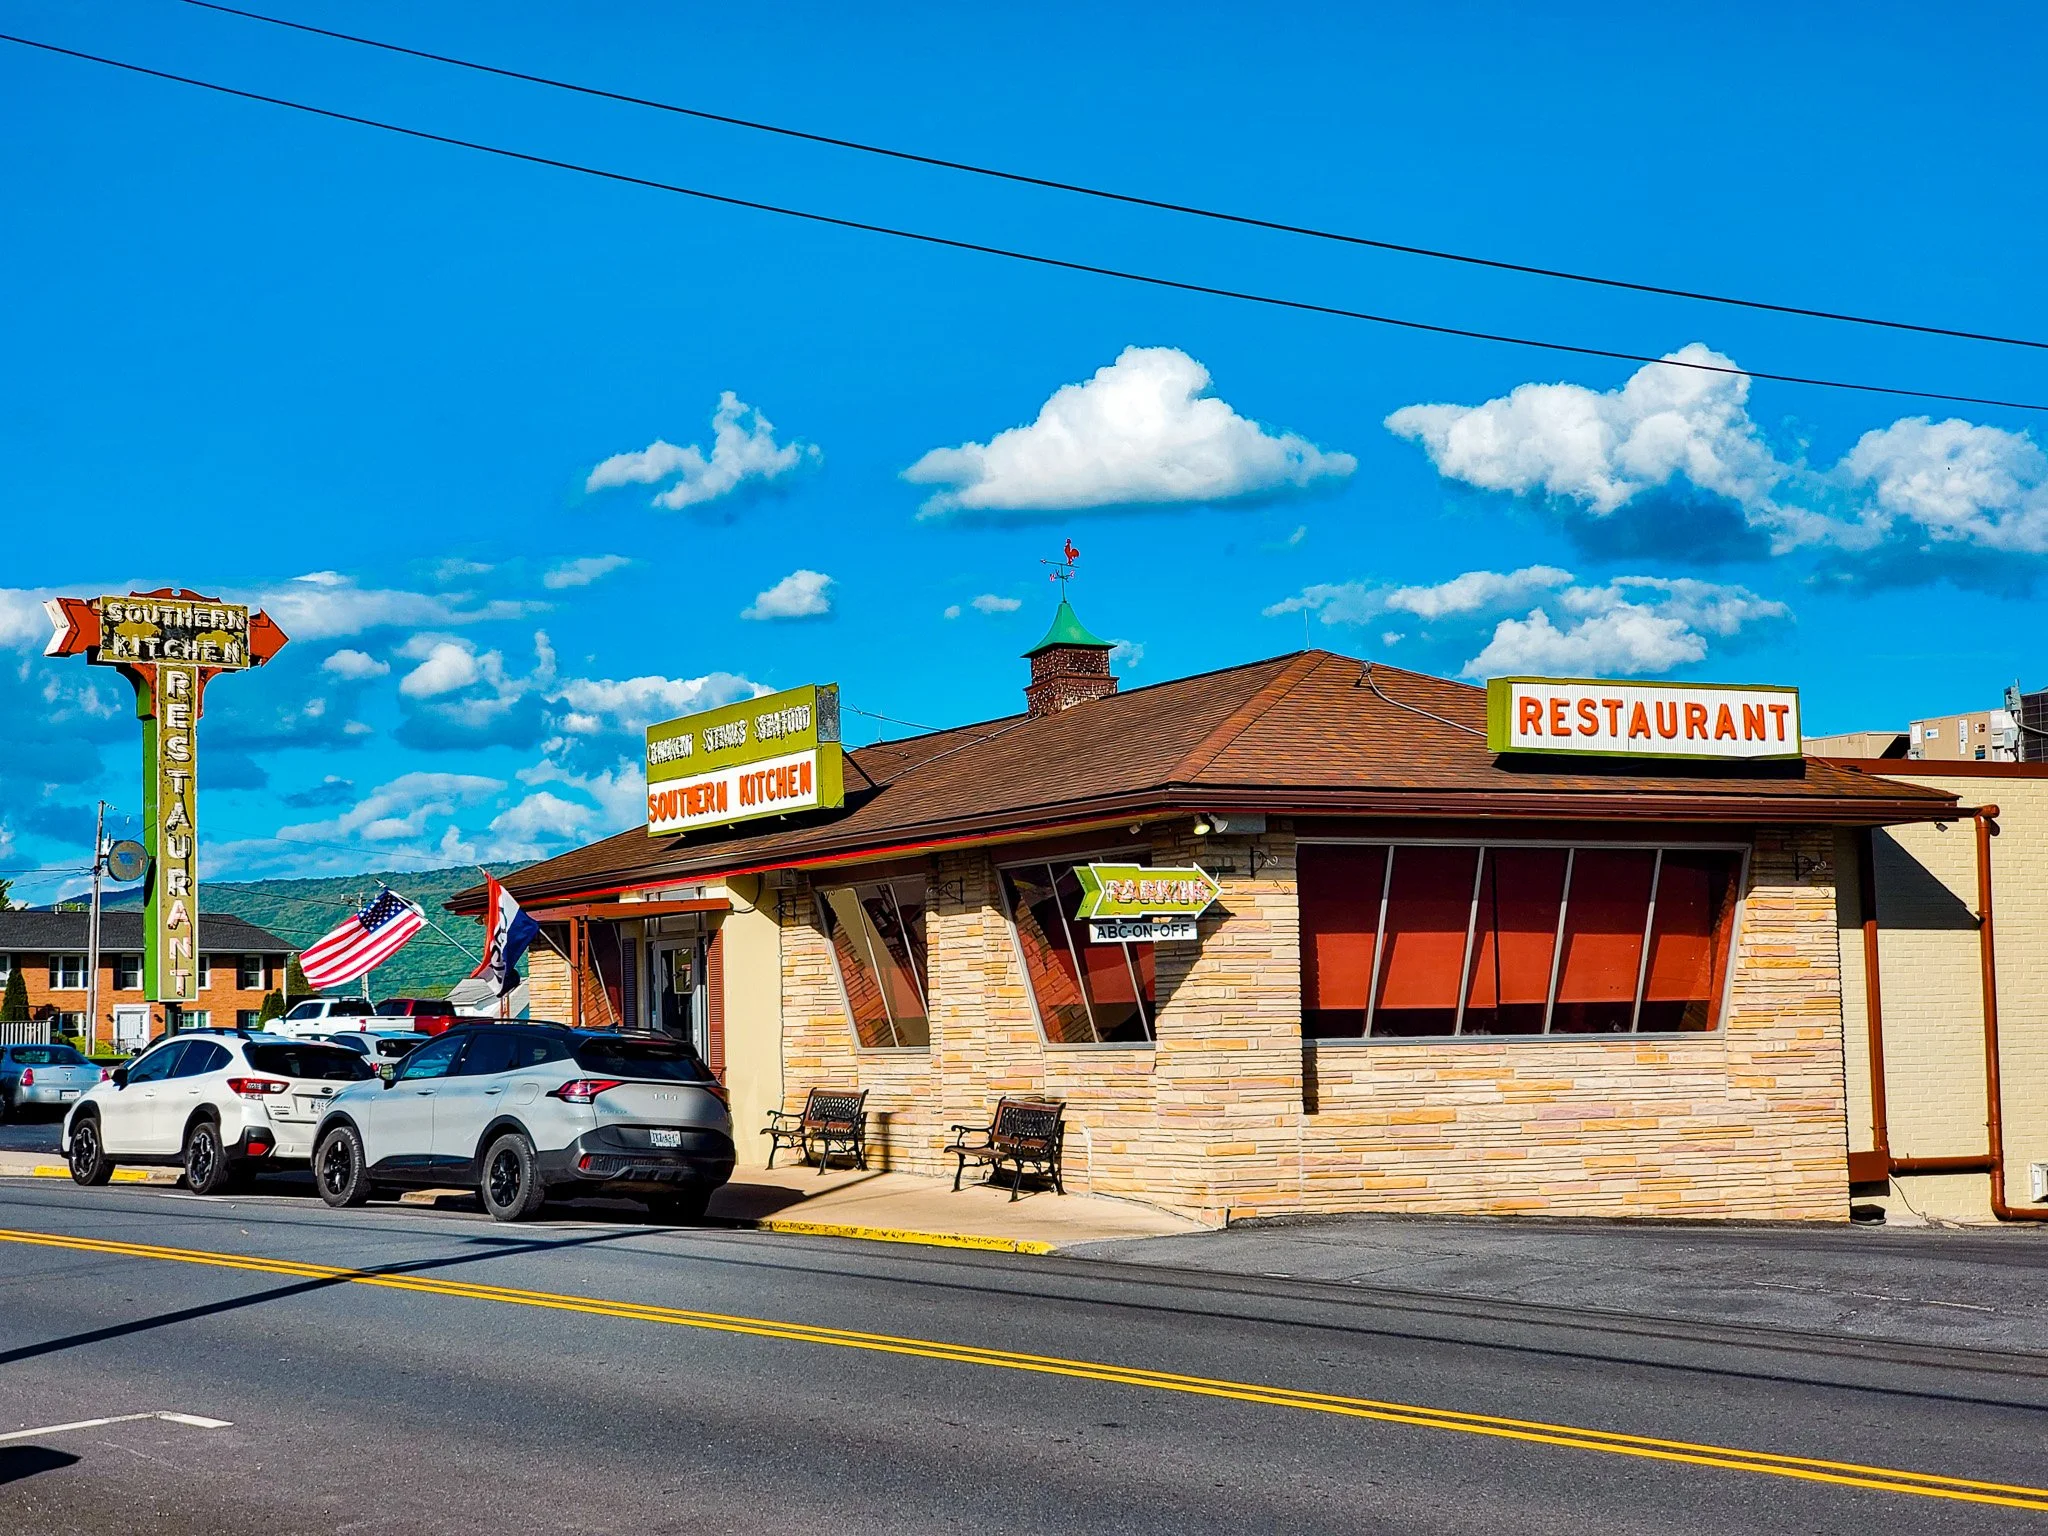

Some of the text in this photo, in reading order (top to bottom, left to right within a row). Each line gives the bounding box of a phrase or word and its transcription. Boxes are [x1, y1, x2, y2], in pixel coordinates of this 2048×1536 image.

[107, 602, 247, 632] SOUTHERN
[112, 632, 242, 664] KITCHEN
[753, 704, 812, 742] SEAFOOD
[1518, 696, 1790, 742] RESTAURANT
[648, 760, 811, 823] SOUTHERN KITCHEN
[166, 670, 194, 999] RESTAURANT
[1097, 923, 1191, 940] ABC-ON-OFF
